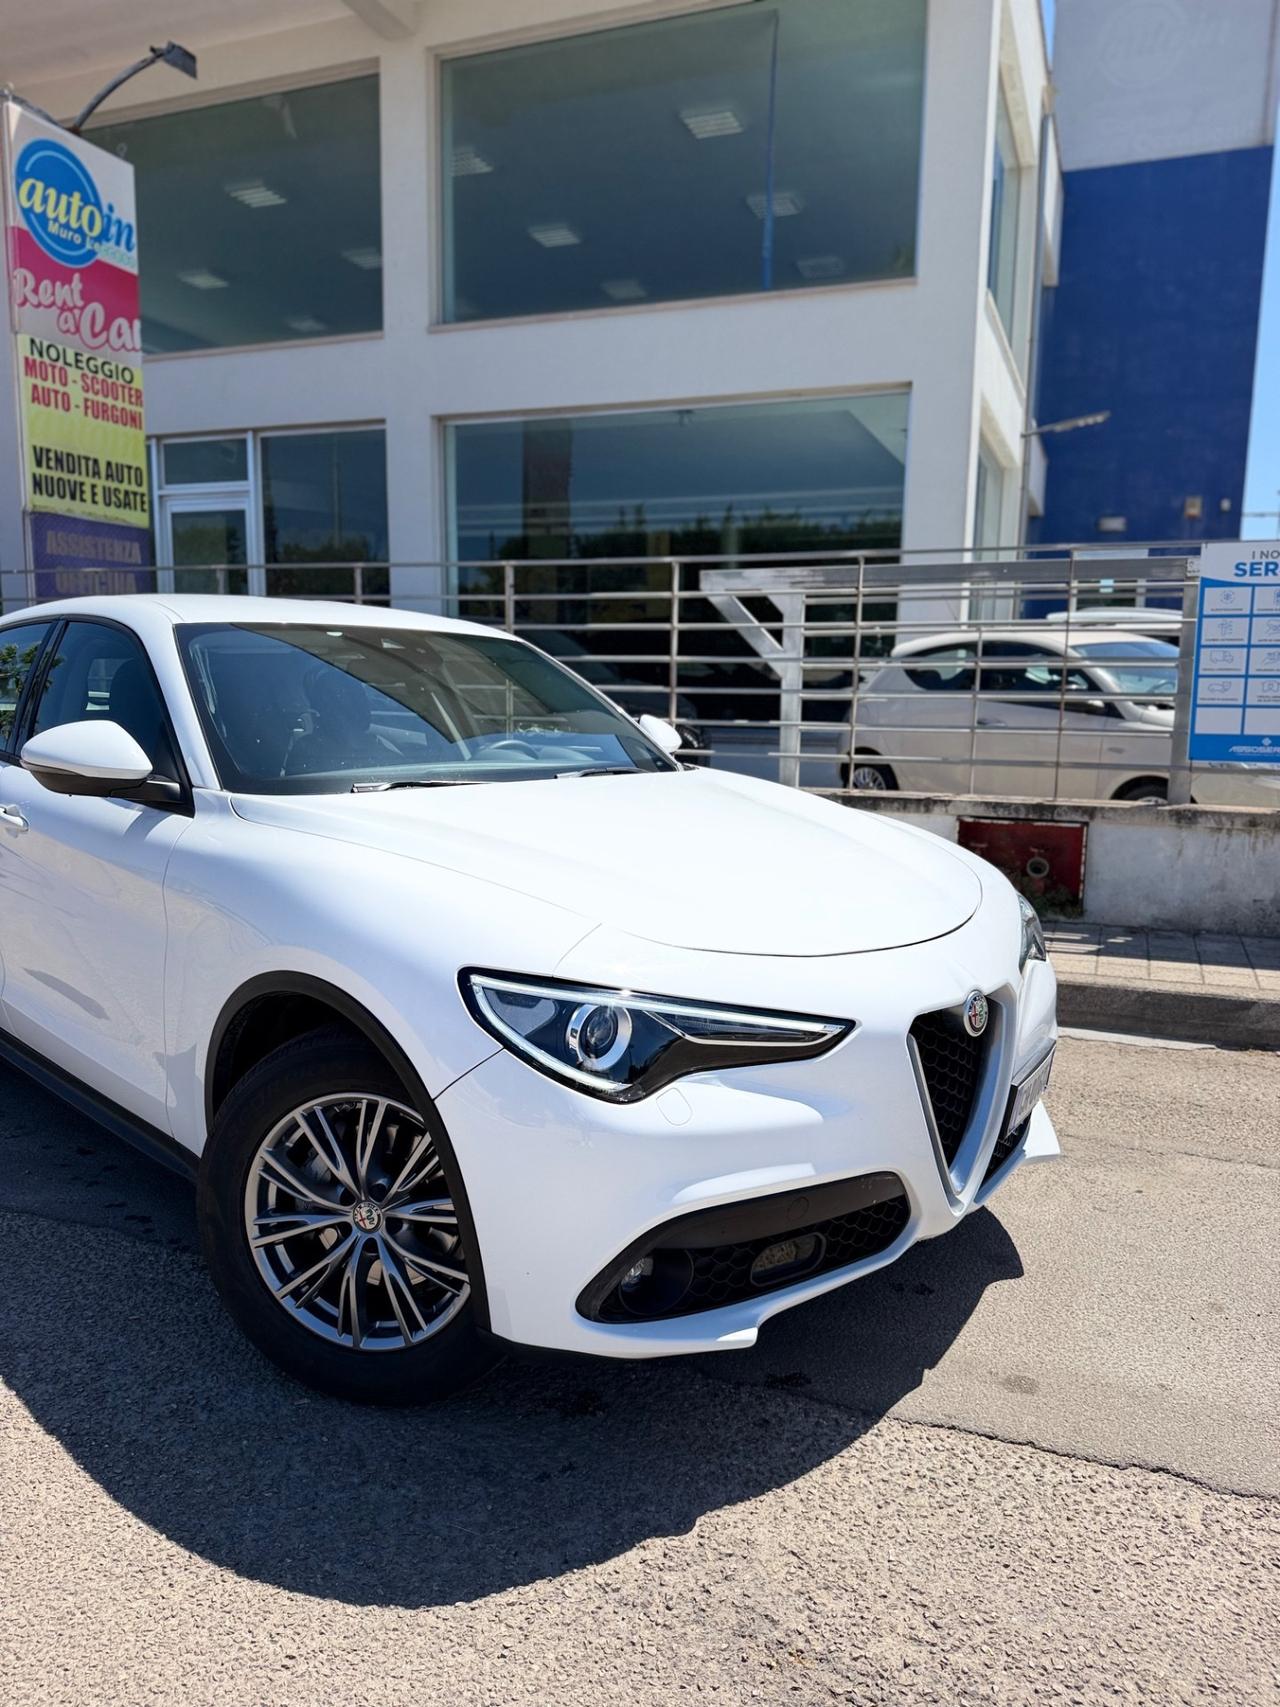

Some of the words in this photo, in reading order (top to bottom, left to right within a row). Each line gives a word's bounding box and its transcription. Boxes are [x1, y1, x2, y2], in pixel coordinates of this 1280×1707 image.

[48, 220, 82, 245] Muro
[14, 267, 84, 308] Rent
[30, 337, 134, 384] NOLEGGIO
[24, 356, 68, 387] MOTO
[80, 372, 143, 408] SCOOTER
[31, 383, 71, 412] AUTO
[83, 397, 143, 430] FURGONI
[32, 445, 100, 480] VENDITA
[104, 461, 143, 487] AUTO
[32, 472, 87, 503] NUOVE
[91, 484, 98, 505] E
[102, 485, 147, 513] USATE
[46, 530, 142, 564] ASSISTENZA
